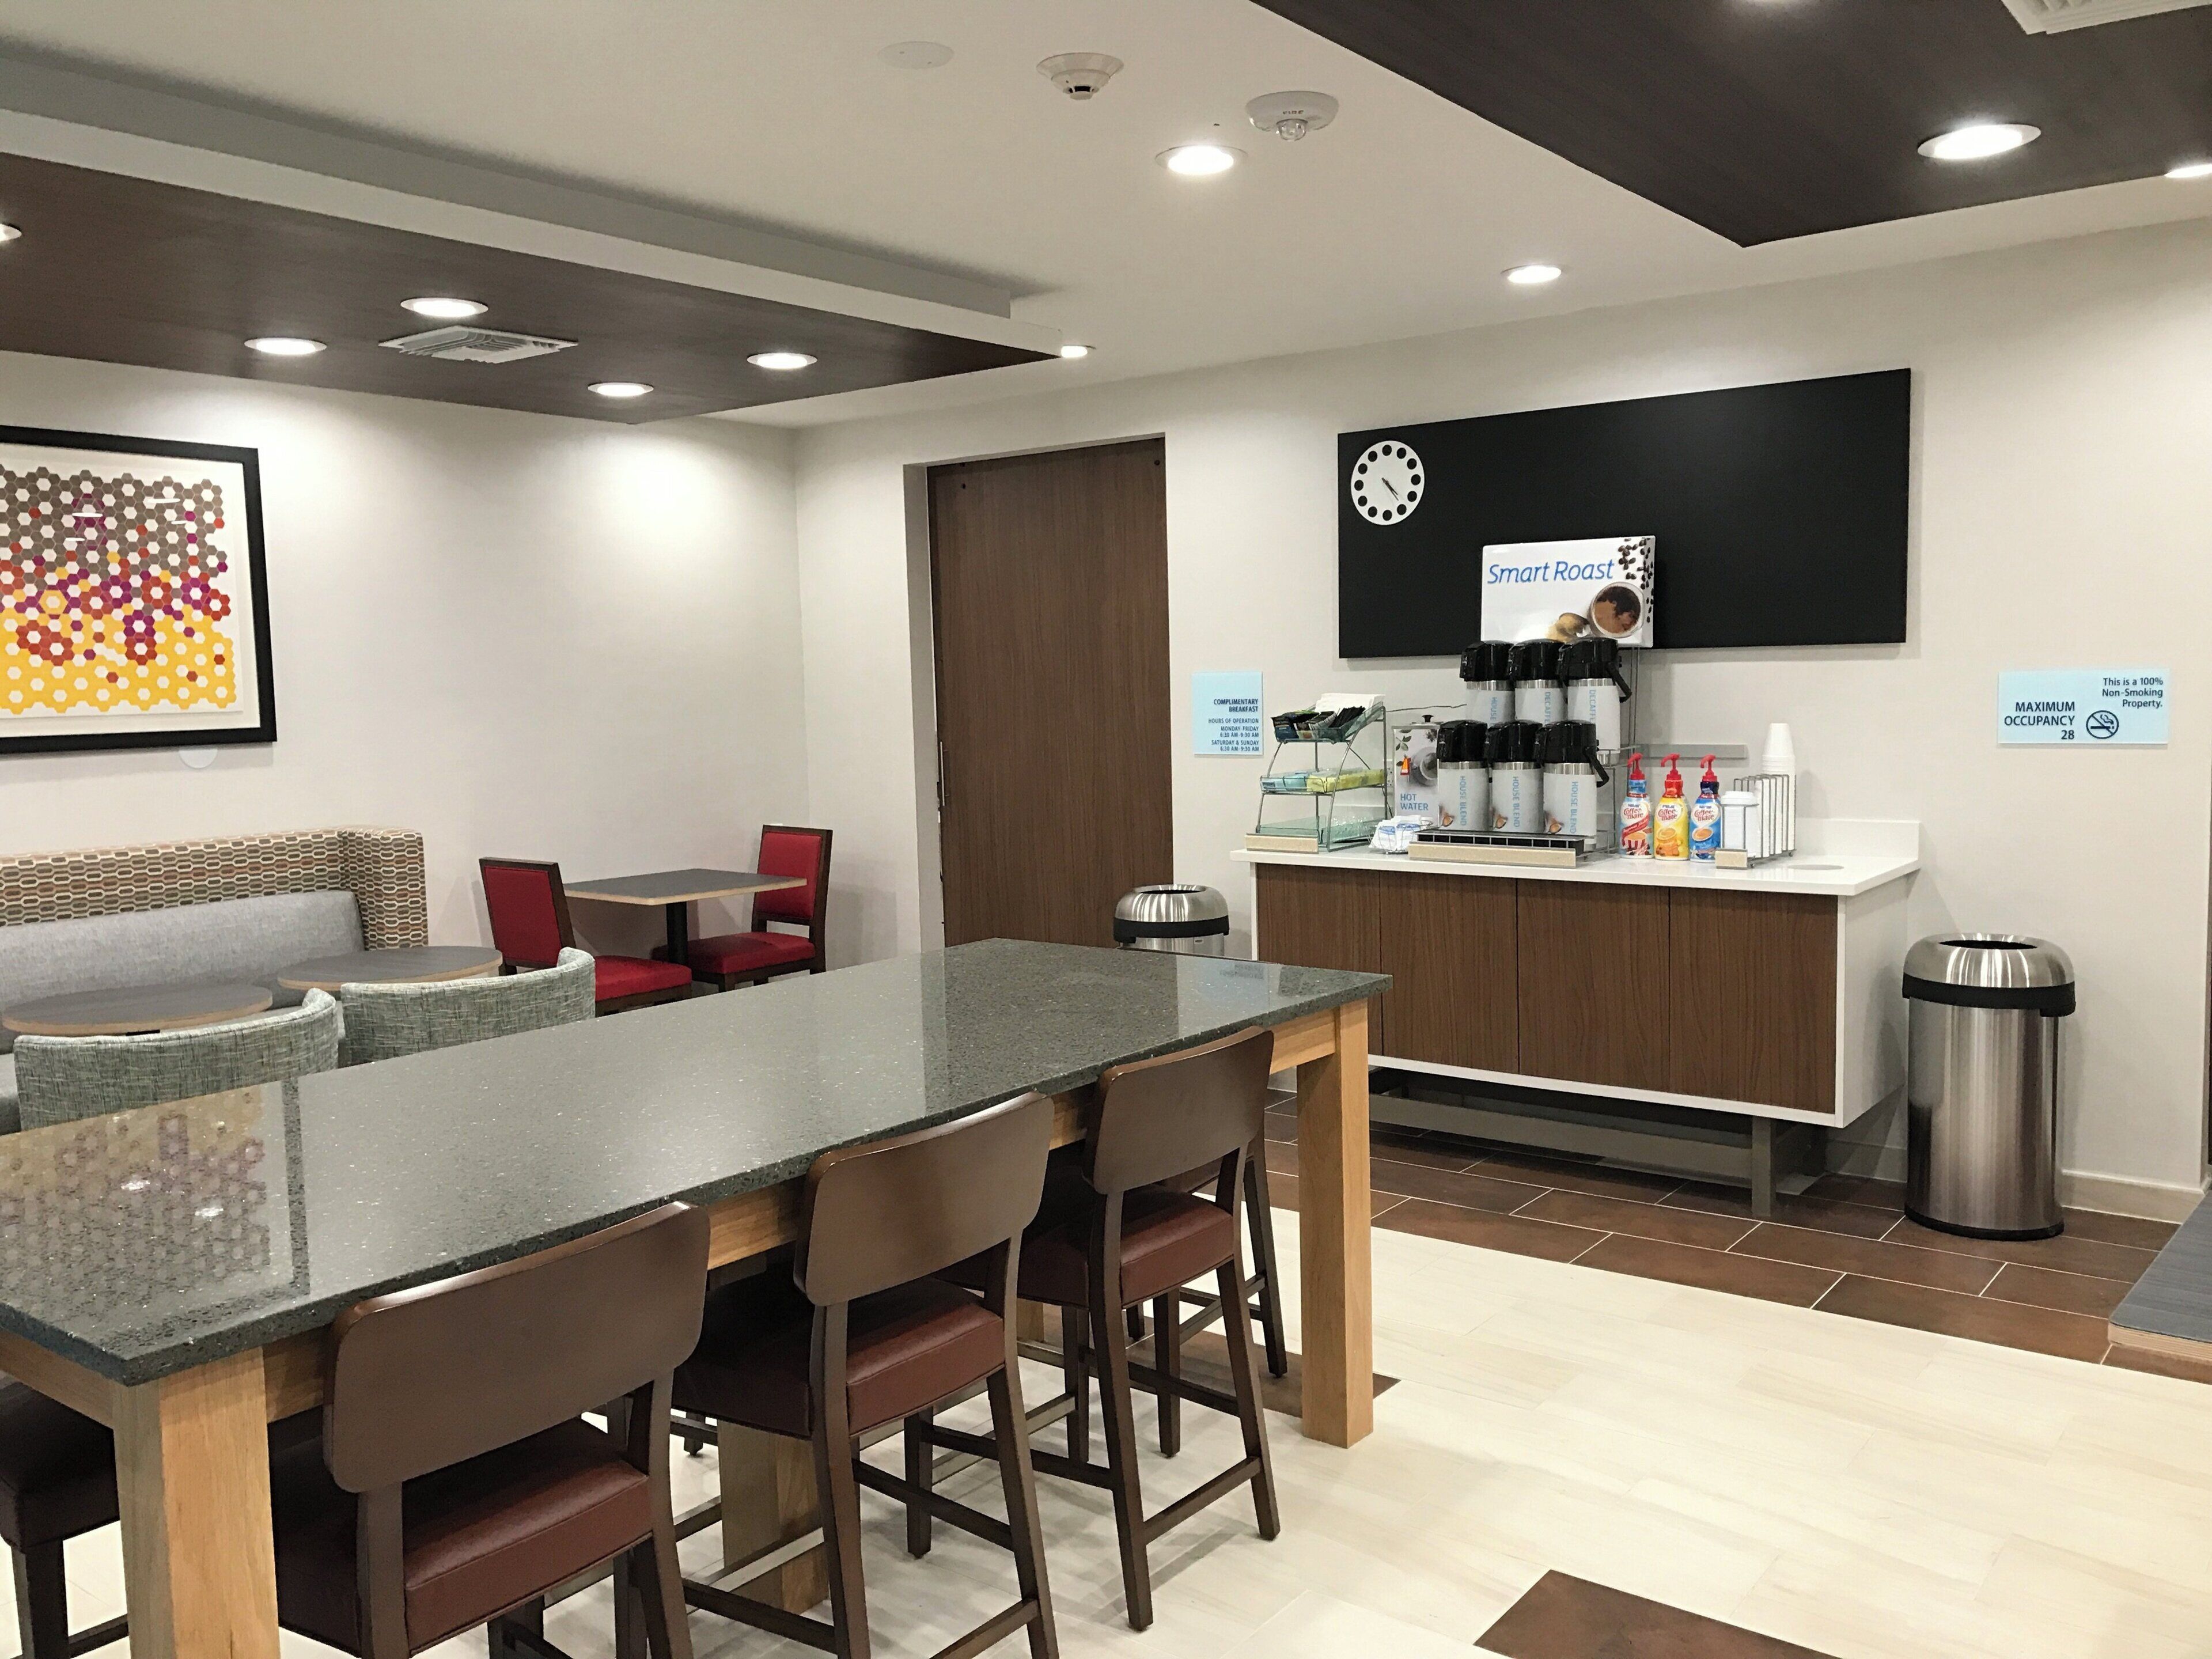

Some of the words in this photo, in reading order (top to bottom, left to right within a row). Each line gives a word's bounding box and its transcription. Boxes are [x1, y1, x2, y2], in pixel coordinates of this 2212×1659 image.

[1487, 562, 1550, 584] Smart
[1554, 559, 1615, 581] Roast
[2103, 677, 2120, 685] This
[2123, 677, 2130, 685] is
[2140, 677, 2164, 685] 100%
[2102, 688, 2163, 698] Non-Smoking
[2015, 702, 2075, 712] MAXIMUM
[2122, 699, 2163, 709] Property.
[2004, 715, 2075, 726] OCCUPANCY
[2061, 730, 2074, 740] 28
[1400, 793, 1416, 801] HOT
[1570, 781, 1578, 806] HOUSE
[1400, 802, 1429, 810] WATER
